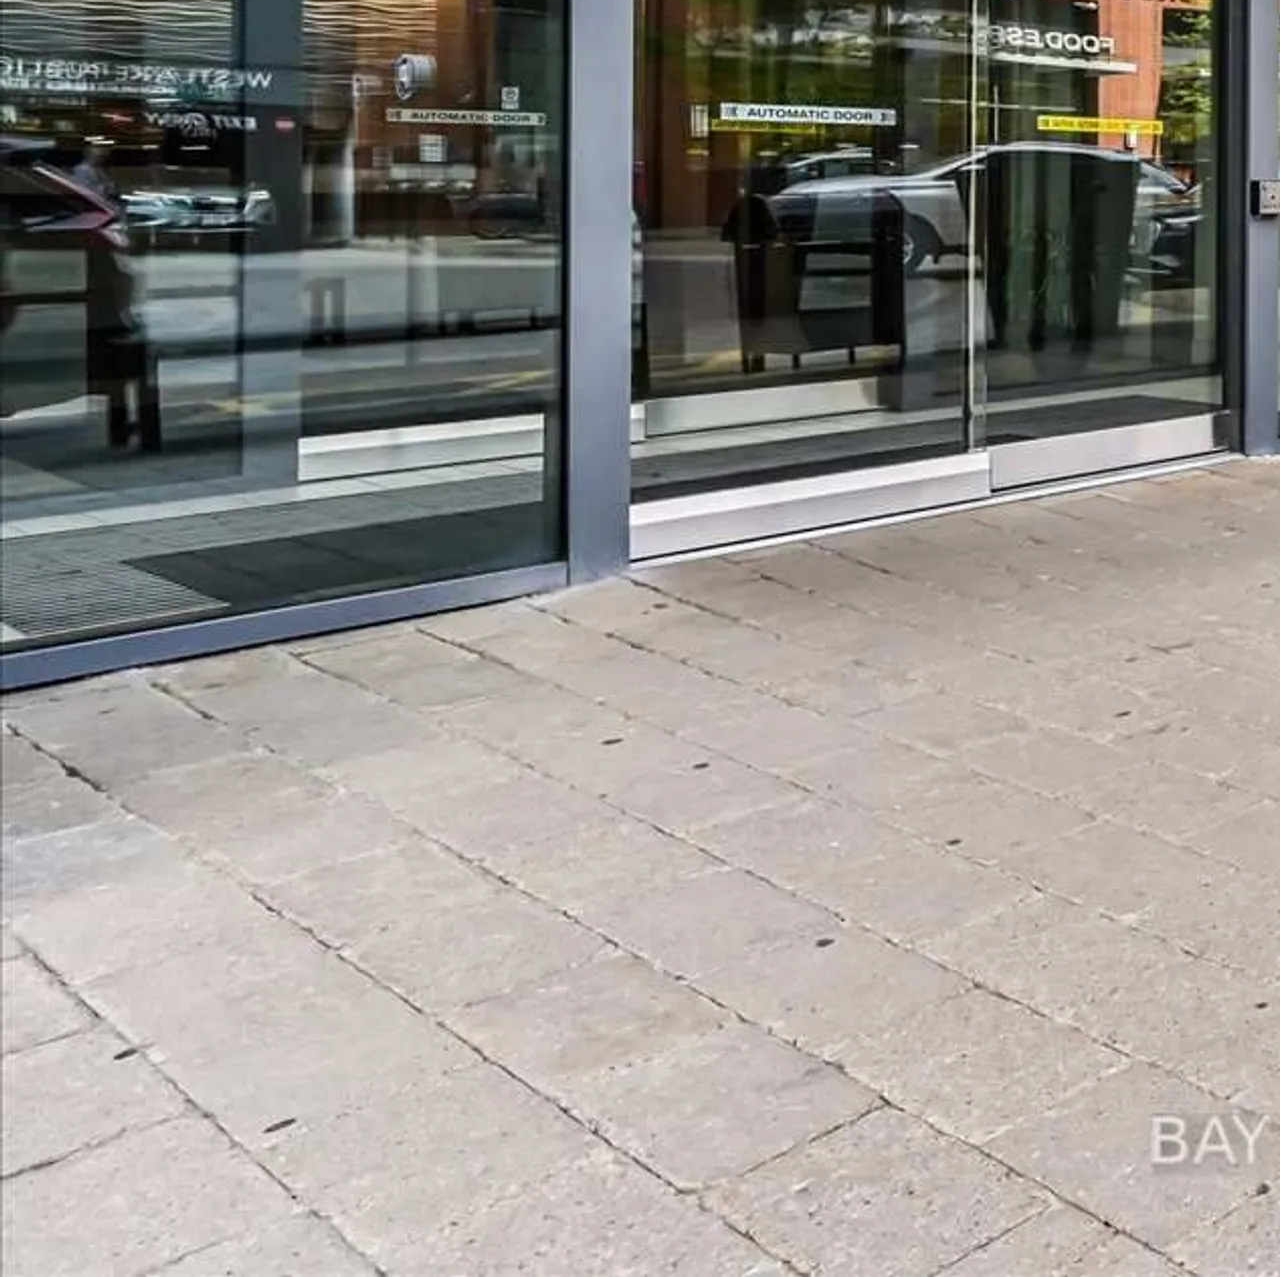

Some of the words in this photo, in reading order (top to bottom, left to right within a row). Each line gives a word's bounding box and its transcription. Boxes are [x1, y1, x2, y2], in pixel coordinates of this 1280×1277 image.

[410, 111, 490, 123] AUTOMATIC
[492, 113, 532, 124] DOOR
[747, 107, 830, 119] AUTOMATIC
[833, 110, 873, 121] DOOR
